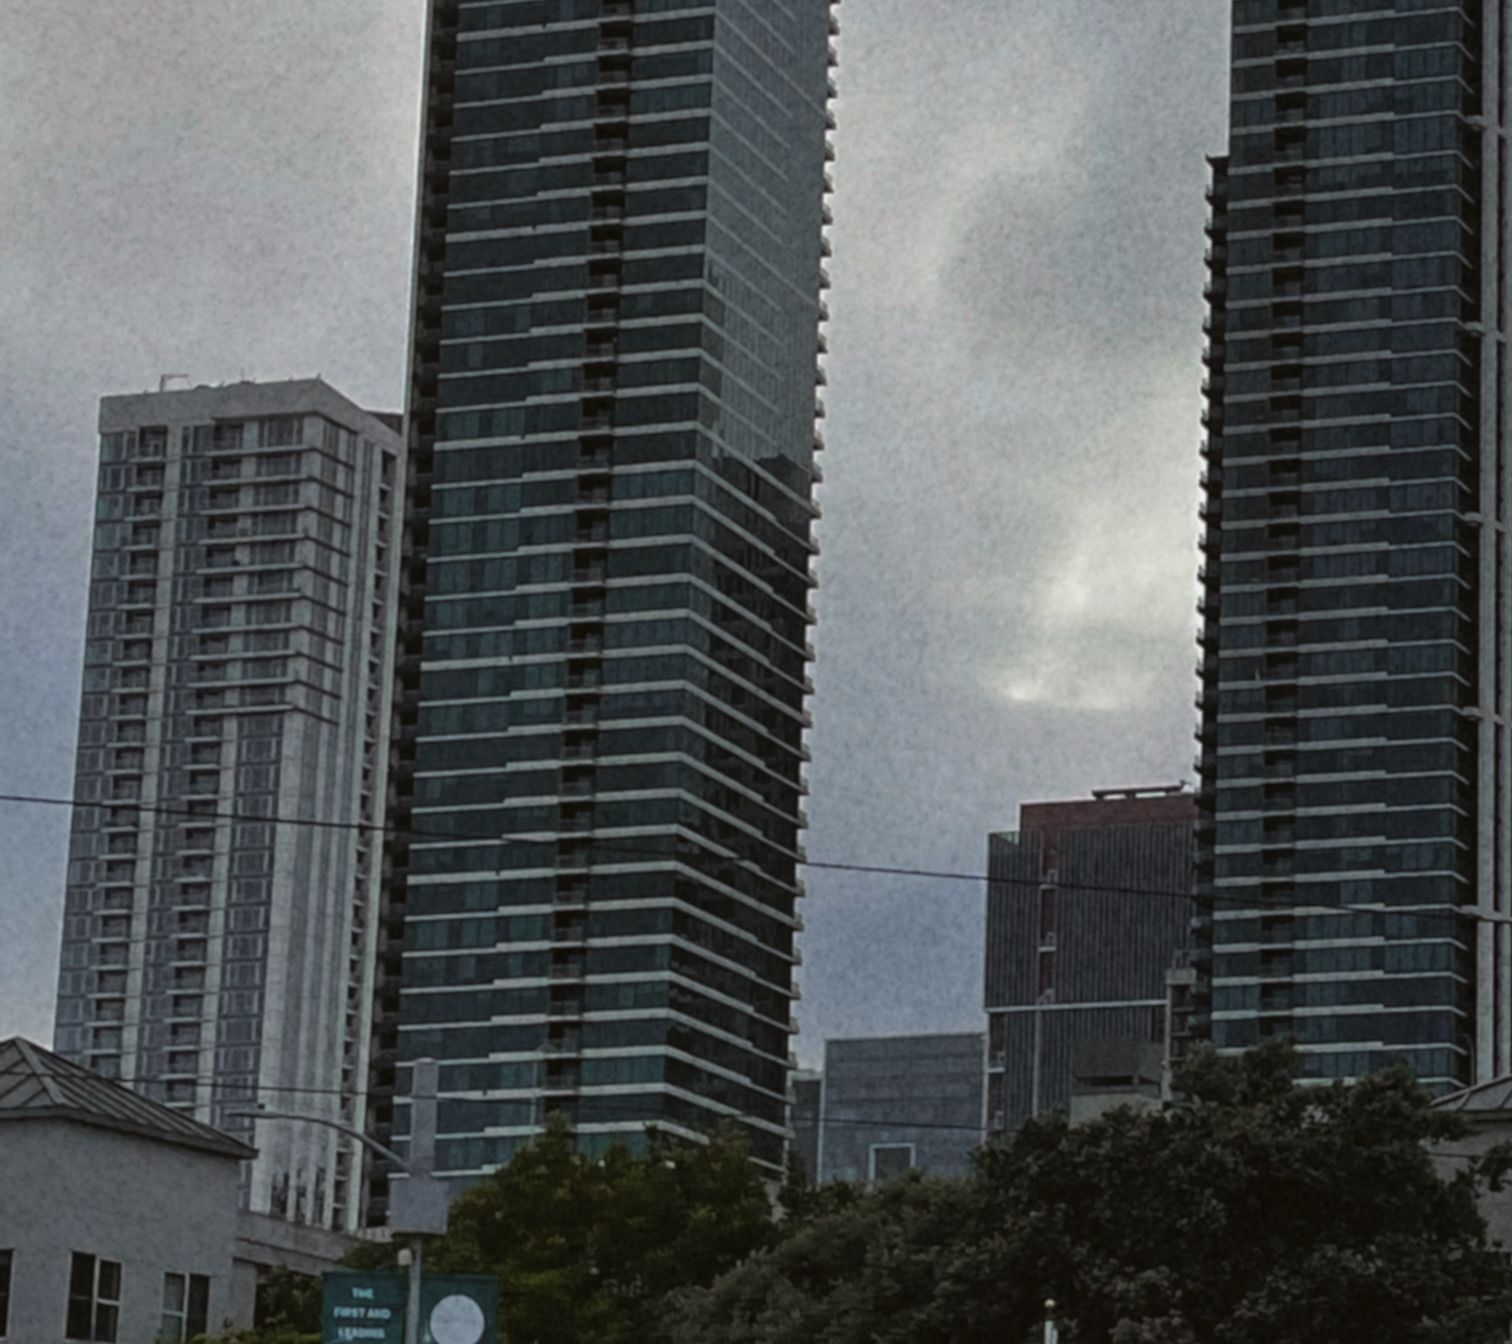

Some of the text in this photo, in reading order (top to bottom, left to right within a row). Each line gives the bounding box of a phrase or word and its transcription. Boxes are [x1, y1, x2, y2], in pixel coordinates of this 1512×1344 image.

[352, 1286, 376, 1300] THE
[333, 1306, 392, 1320] FIRST AND
[337, 1326, 386, 1340] LEADING
